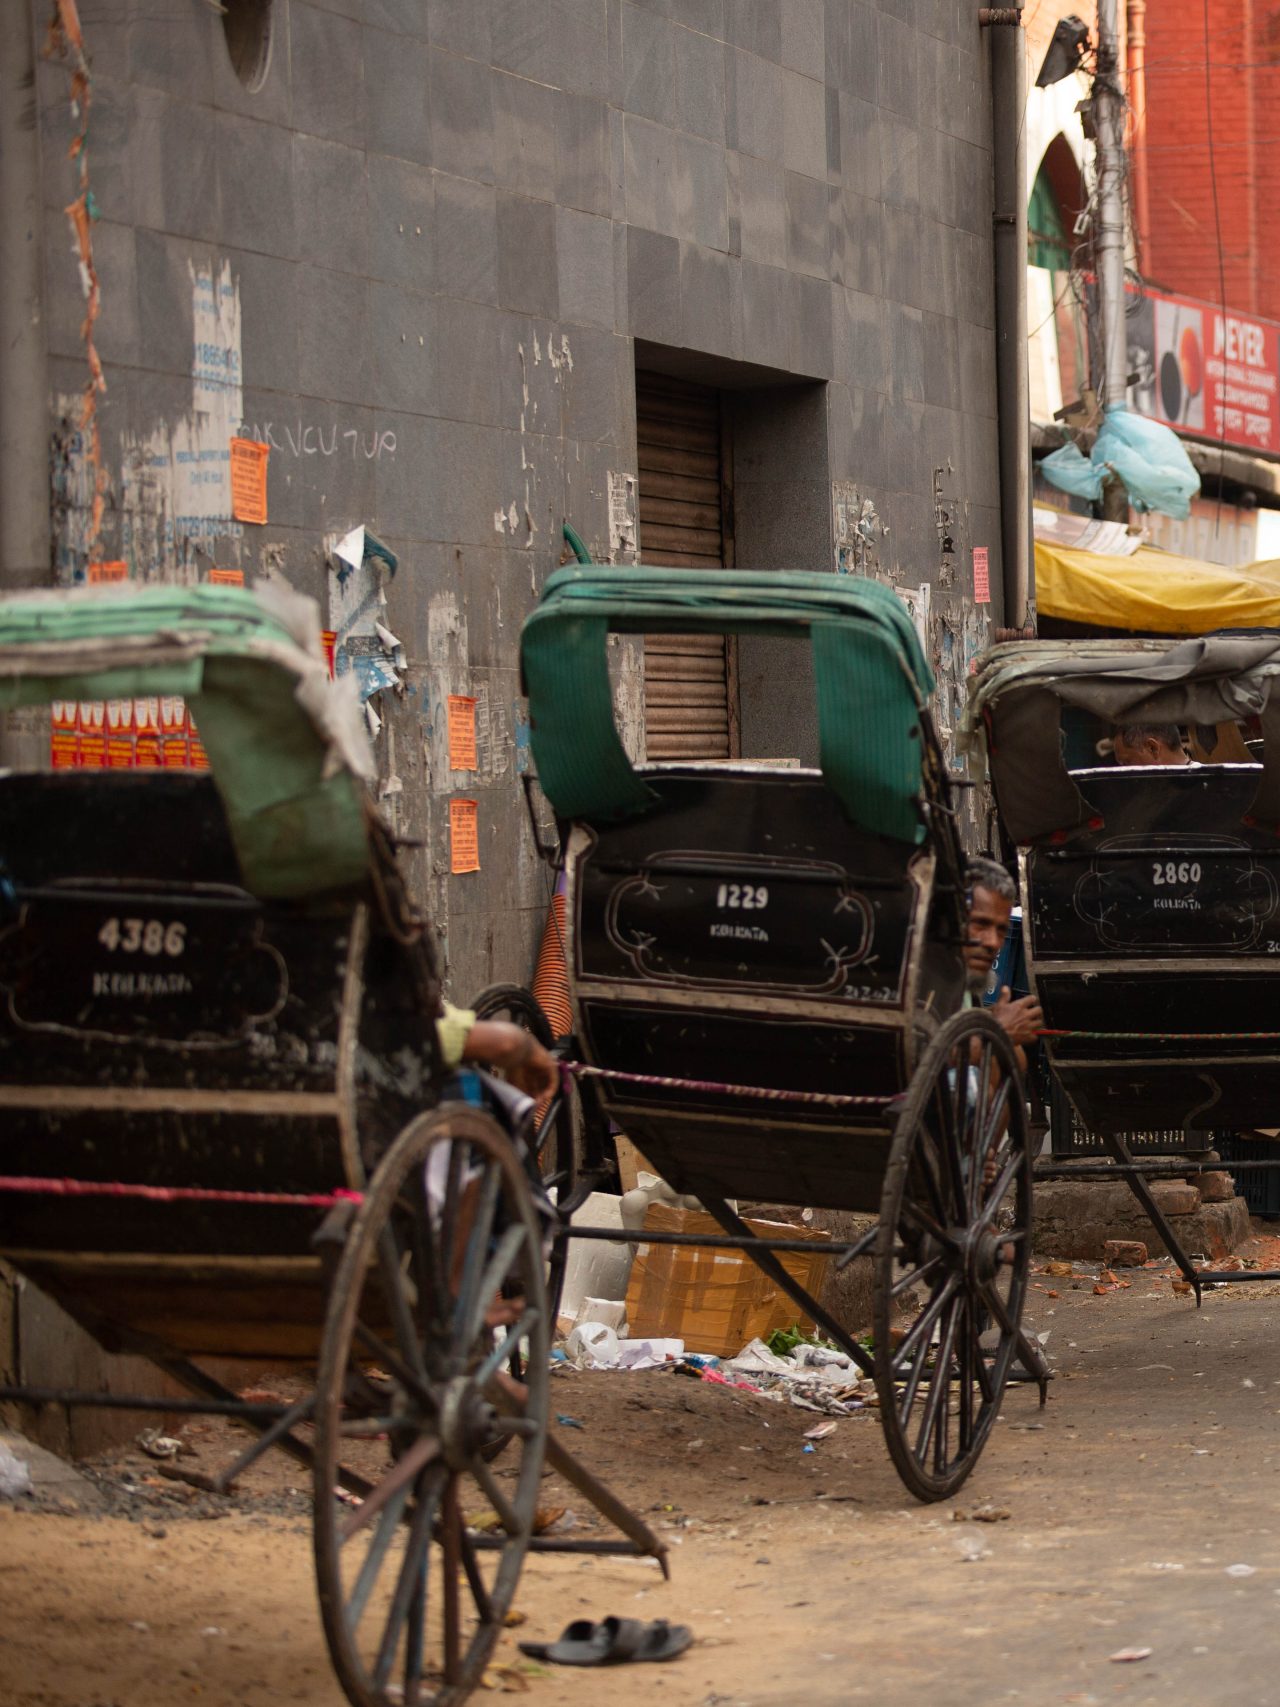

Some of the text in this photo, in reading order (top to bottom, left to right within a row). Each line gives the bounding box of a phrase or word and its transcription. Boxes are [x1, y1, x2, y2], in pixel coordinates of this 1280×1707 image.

[1213, 315, 1266, 368] MEYER
[1152, 862, 1202, 885] 2860
[717, 884, 769, 909] 1229
[98, 917, 187, 956] 4386
